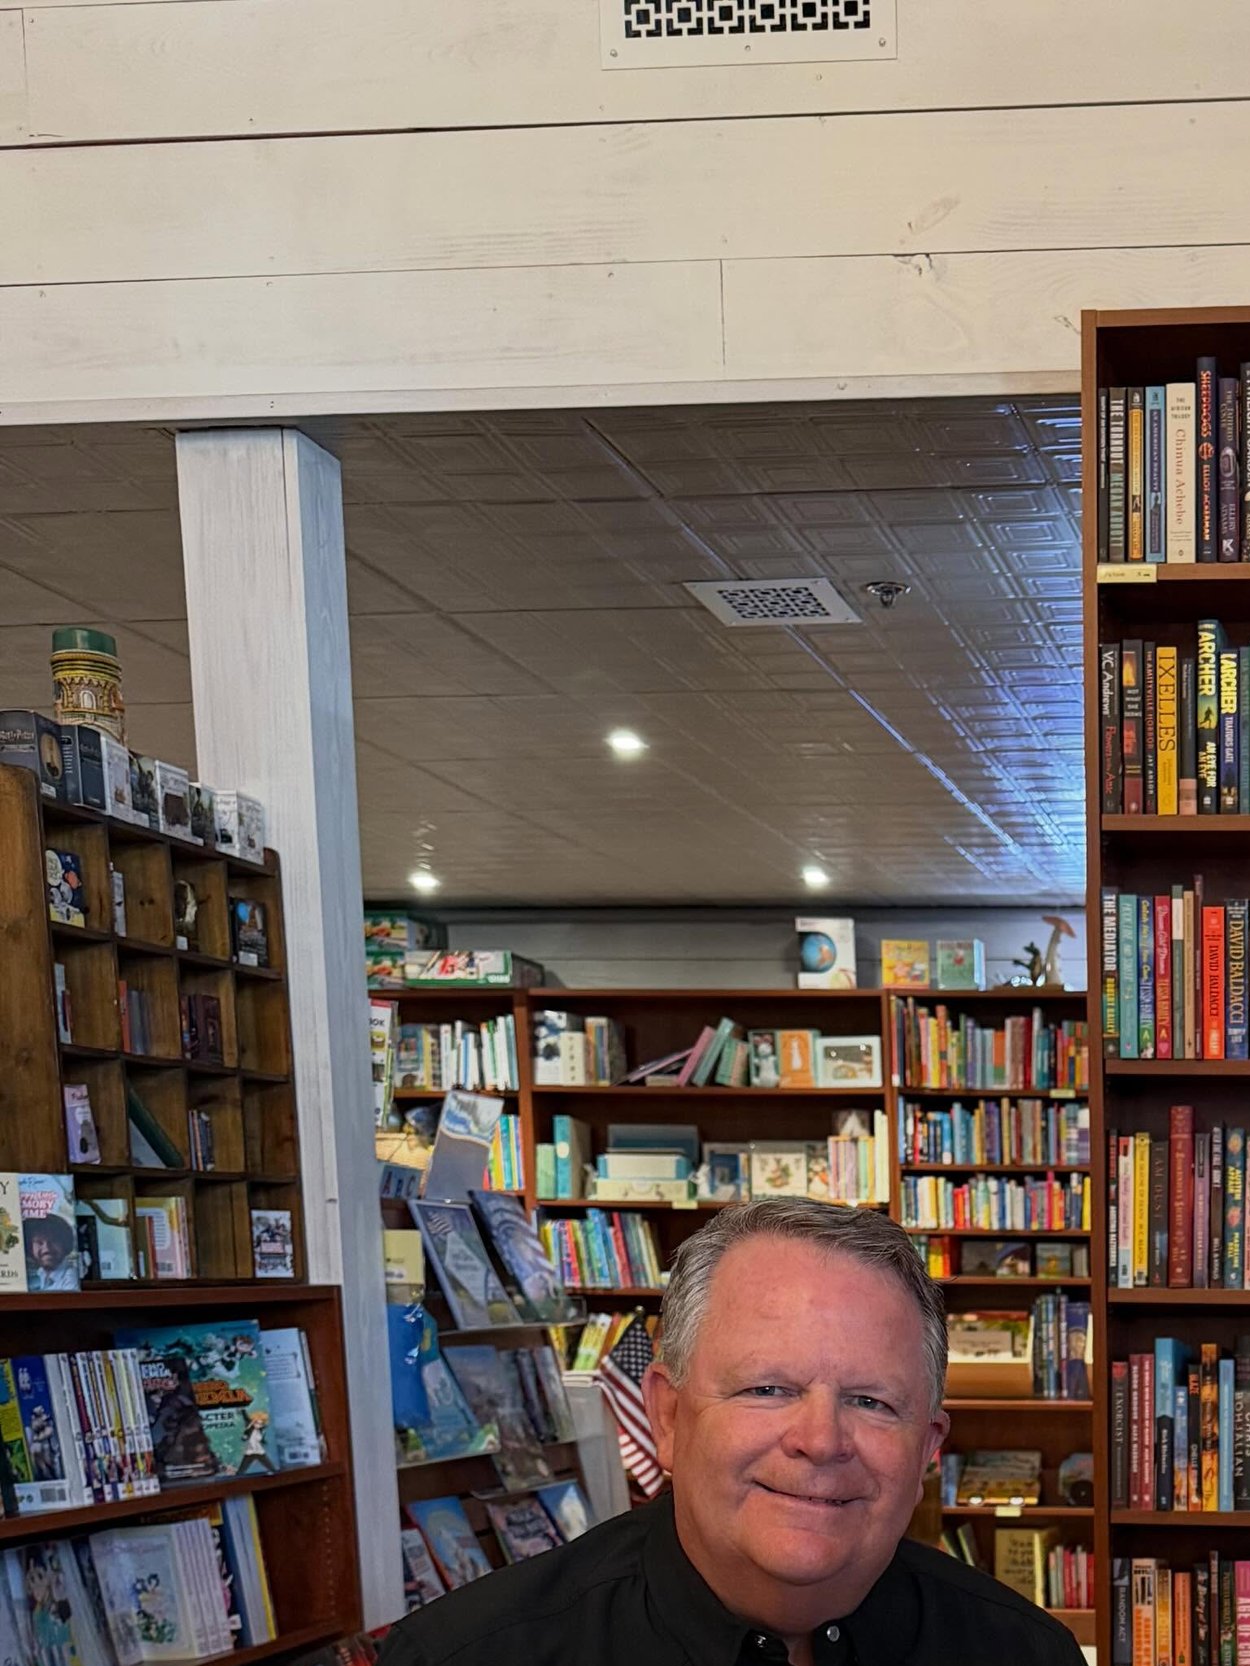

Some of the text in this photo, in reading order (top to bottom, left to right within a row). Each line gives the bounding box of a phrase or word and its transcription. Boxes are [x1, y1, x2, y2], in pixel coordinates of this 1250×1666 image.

[1157, 655, 1177, 753] IXELLES
[1103, 894, 1117, 971] THE MEDIATOR
